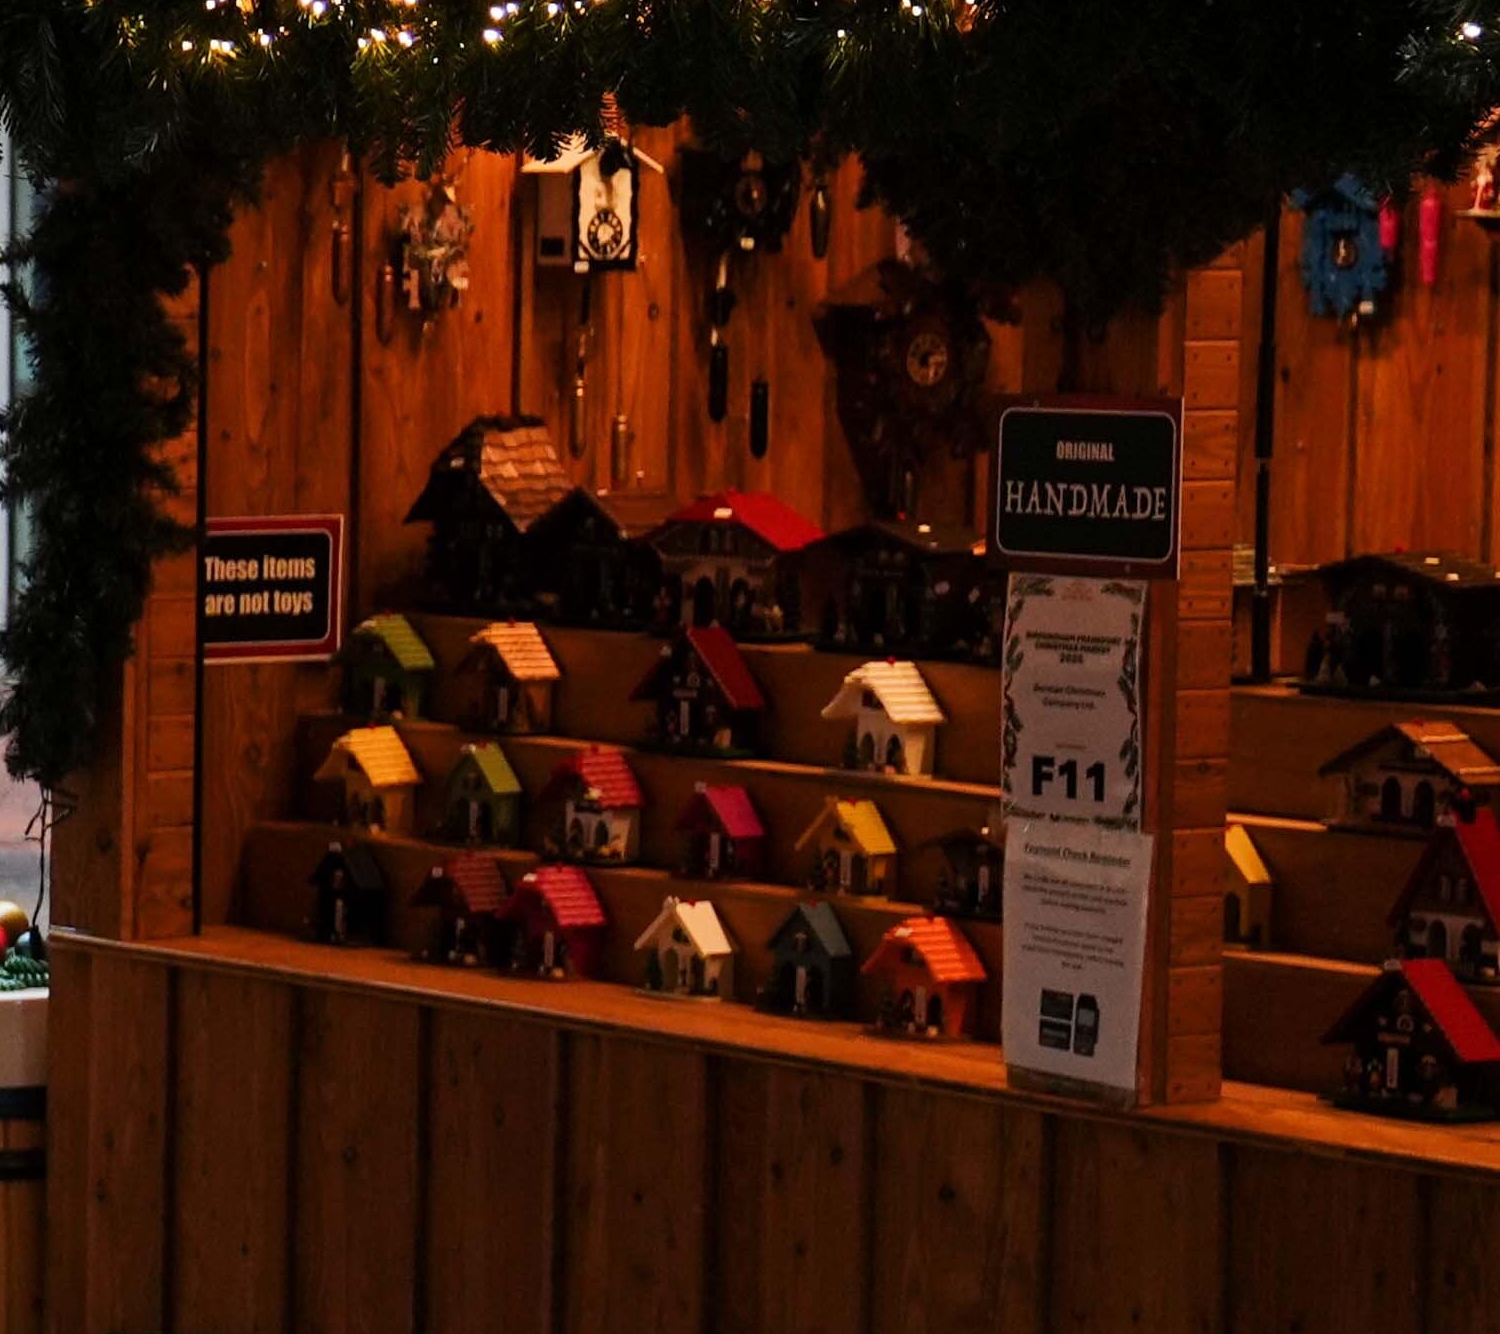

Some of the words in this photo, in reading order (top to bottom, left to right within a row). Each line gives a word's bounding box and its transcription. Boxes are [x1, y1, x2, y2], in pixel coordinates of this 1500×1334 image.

[1055, 439, 1115, 463] ORIGINAL
[1004, 480, 1167, 522] HANDMADE
[204, 555, 259, 582] These
[263, 554, 316, 580] items
[205, 594, 236, 616] are
[239, 590, 269, 615] not
[273, 590, 314, 616] toys
[1031, 754, 1106, 803] F11
